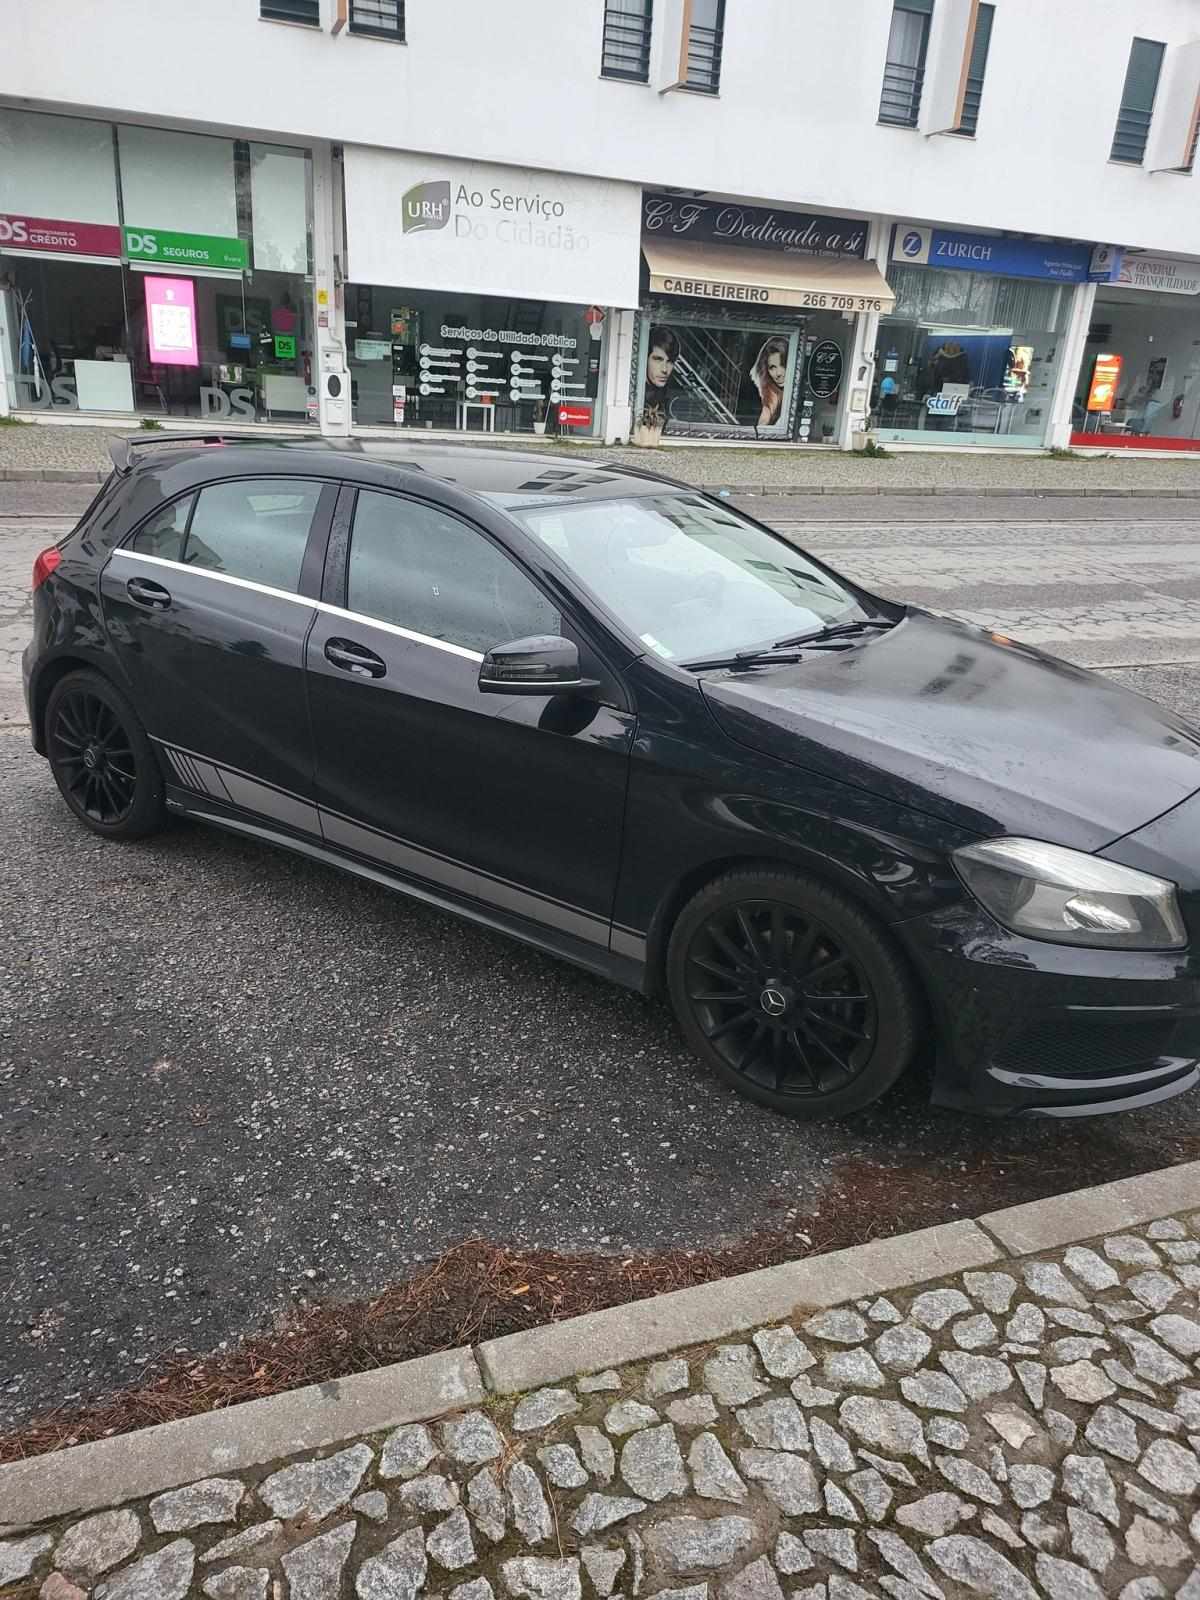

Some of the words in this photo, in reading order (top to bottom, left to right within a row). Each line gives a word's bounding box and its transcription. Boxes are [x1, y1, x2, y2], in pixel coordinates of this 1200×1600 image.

[455, 184, 484, 208] Ao
[490, 188, 565, 221] Serviço
[30, 233, 77, 247] CRÉDITO
[455, 214, 488, 241] Do
[495, 219, 591, 253] Cidadão
[713, 207, 821, 247] Dedicado
[826, 233, 842, 249] a
[843, 230, 864, 252] si
[126, 233, 158, 255] DS
[163, 247, 209, 260] SEGUROS
[936, 240, 992, 262] ZURICH
[663, 279, 769, 302] CABELEIREIRO
[802, 293, 826, 308] 266
[831, 296, 854, 310] 709
[857, 299, 881, 312] 376
[440, 324, 482, 341] Serviços
[483, 329, 498, 341] de
[200, 385, 256, 420] DS
[928, 394, 961, 410] staff
